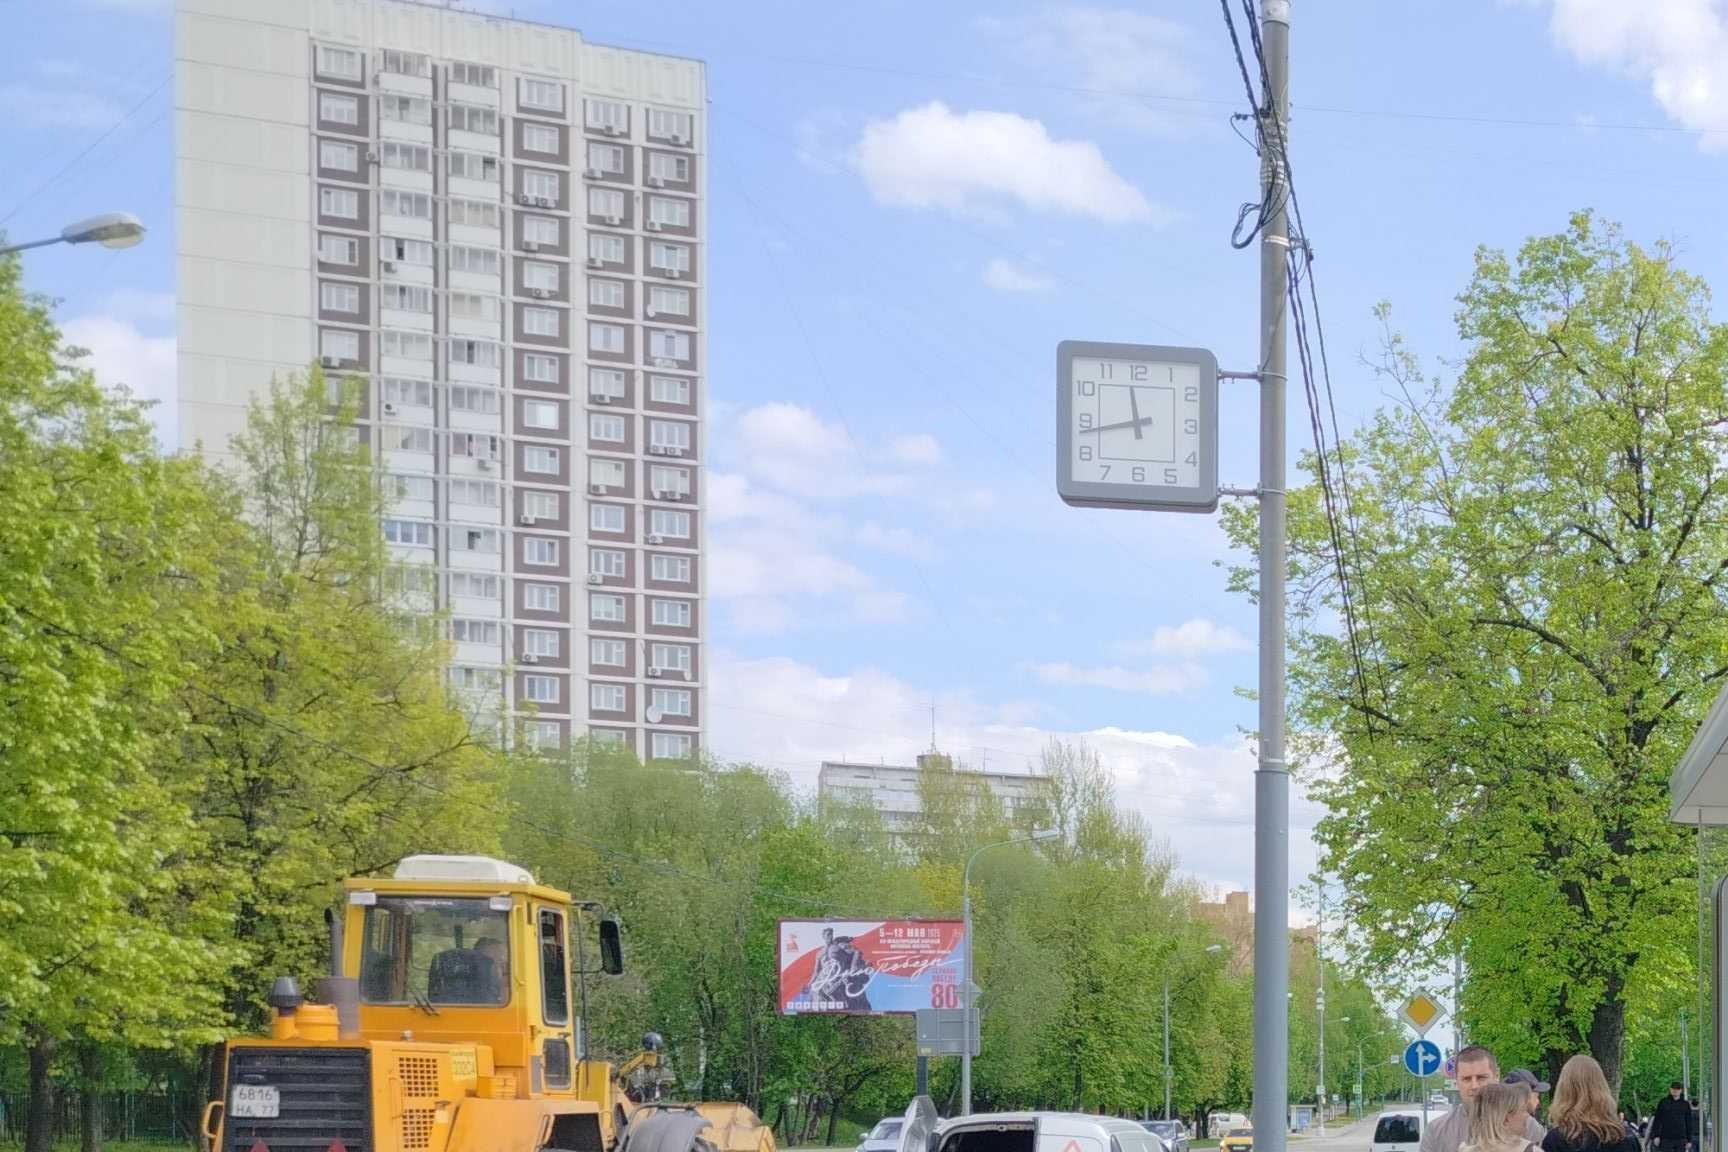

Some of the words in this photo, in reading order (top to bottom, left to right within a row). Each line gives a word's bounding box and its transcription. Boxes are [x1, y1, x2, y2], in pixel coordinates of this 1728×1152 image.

[1100, 363, 1113, 379] 11
[1130, 365, 1148, 381] 12
[1168, 367, 1174, 382] 1
[1077, 380, 1095, 396] 10
[1184, 386, 1198, 402] 2
[1079, 413, 1092, 429] 9
[1184, 419, 1198, 435] 3
[1079, 446, 1092, 461] 8
[1184, 451, 1197, 467] 4
[1100, 465, 1111, 481] 7
[1132, 467, 1145, 482] 6
[1164, 468, 1177, 484] 5
